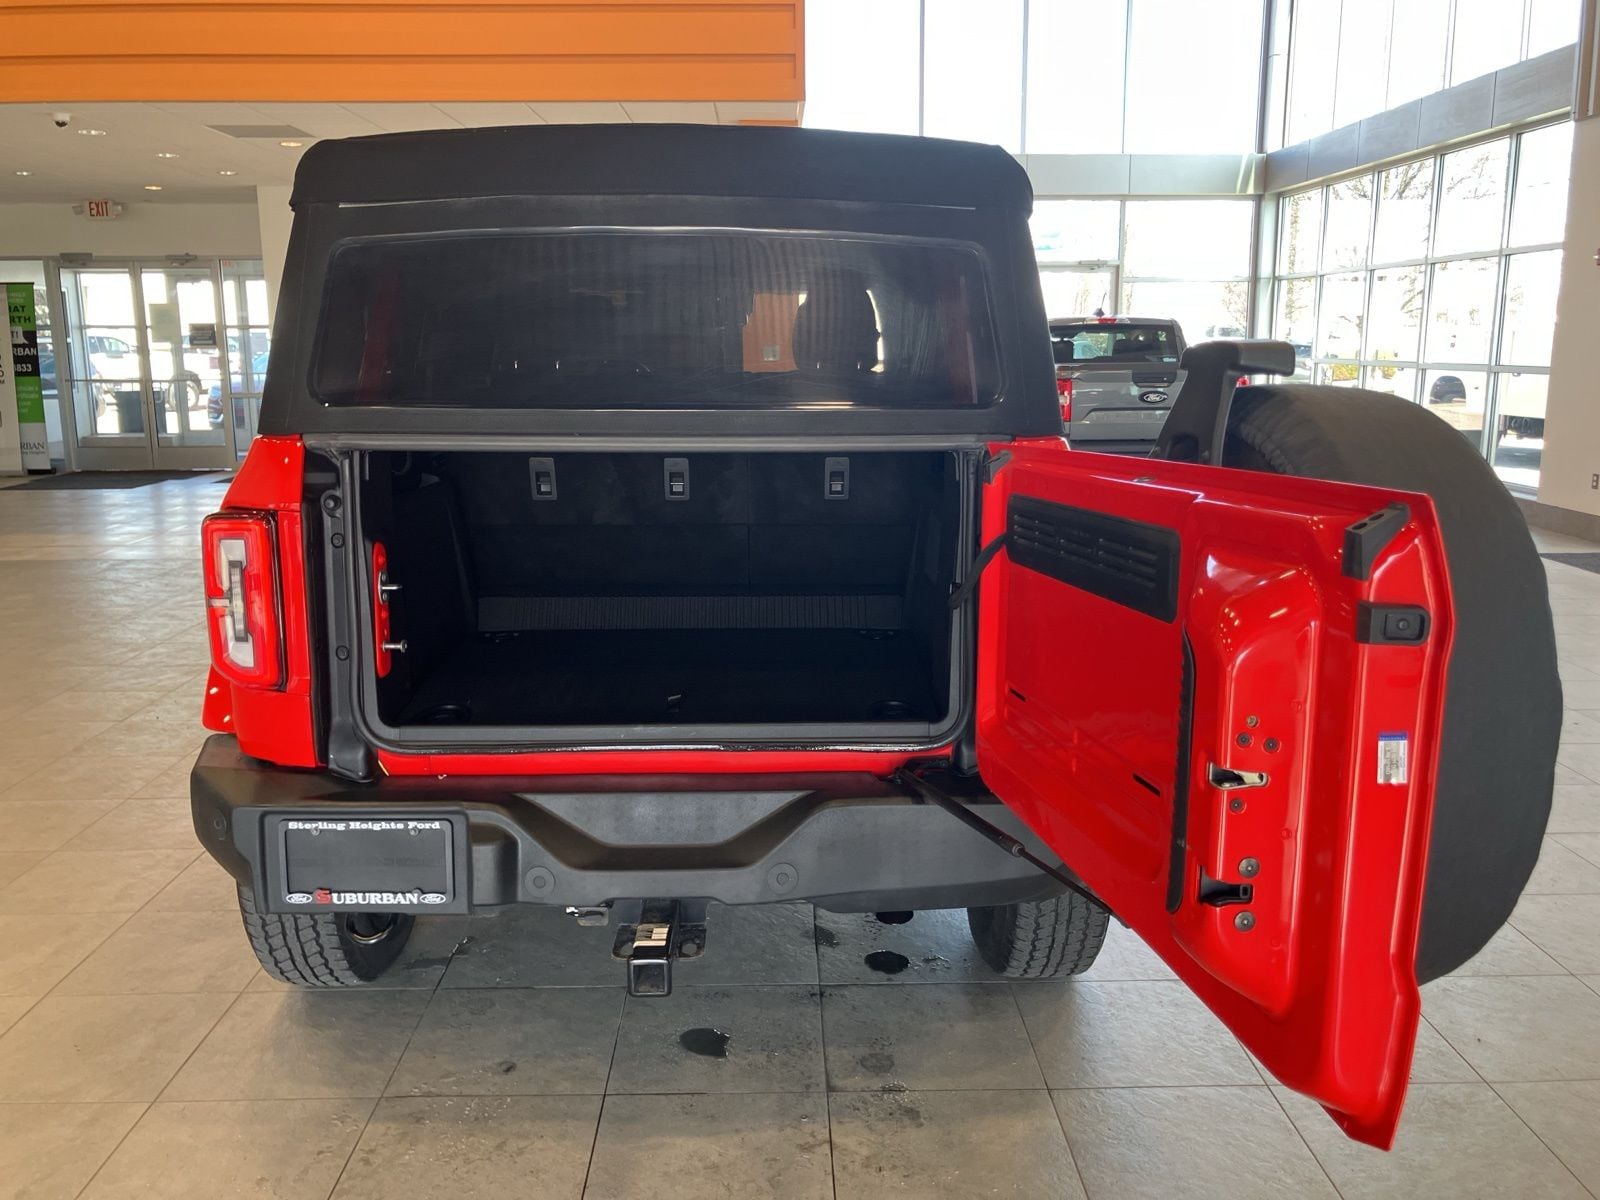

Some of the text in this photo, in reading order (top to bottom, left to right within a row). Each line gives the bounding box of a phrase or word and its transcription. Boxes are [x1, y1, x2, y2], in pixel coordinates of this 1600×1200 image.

[89, 201, 109, 216] EXIT
[288, 821, 441, 831] Sterling Heights Ford
[316, 888, 418, 904] SUBURBAN
